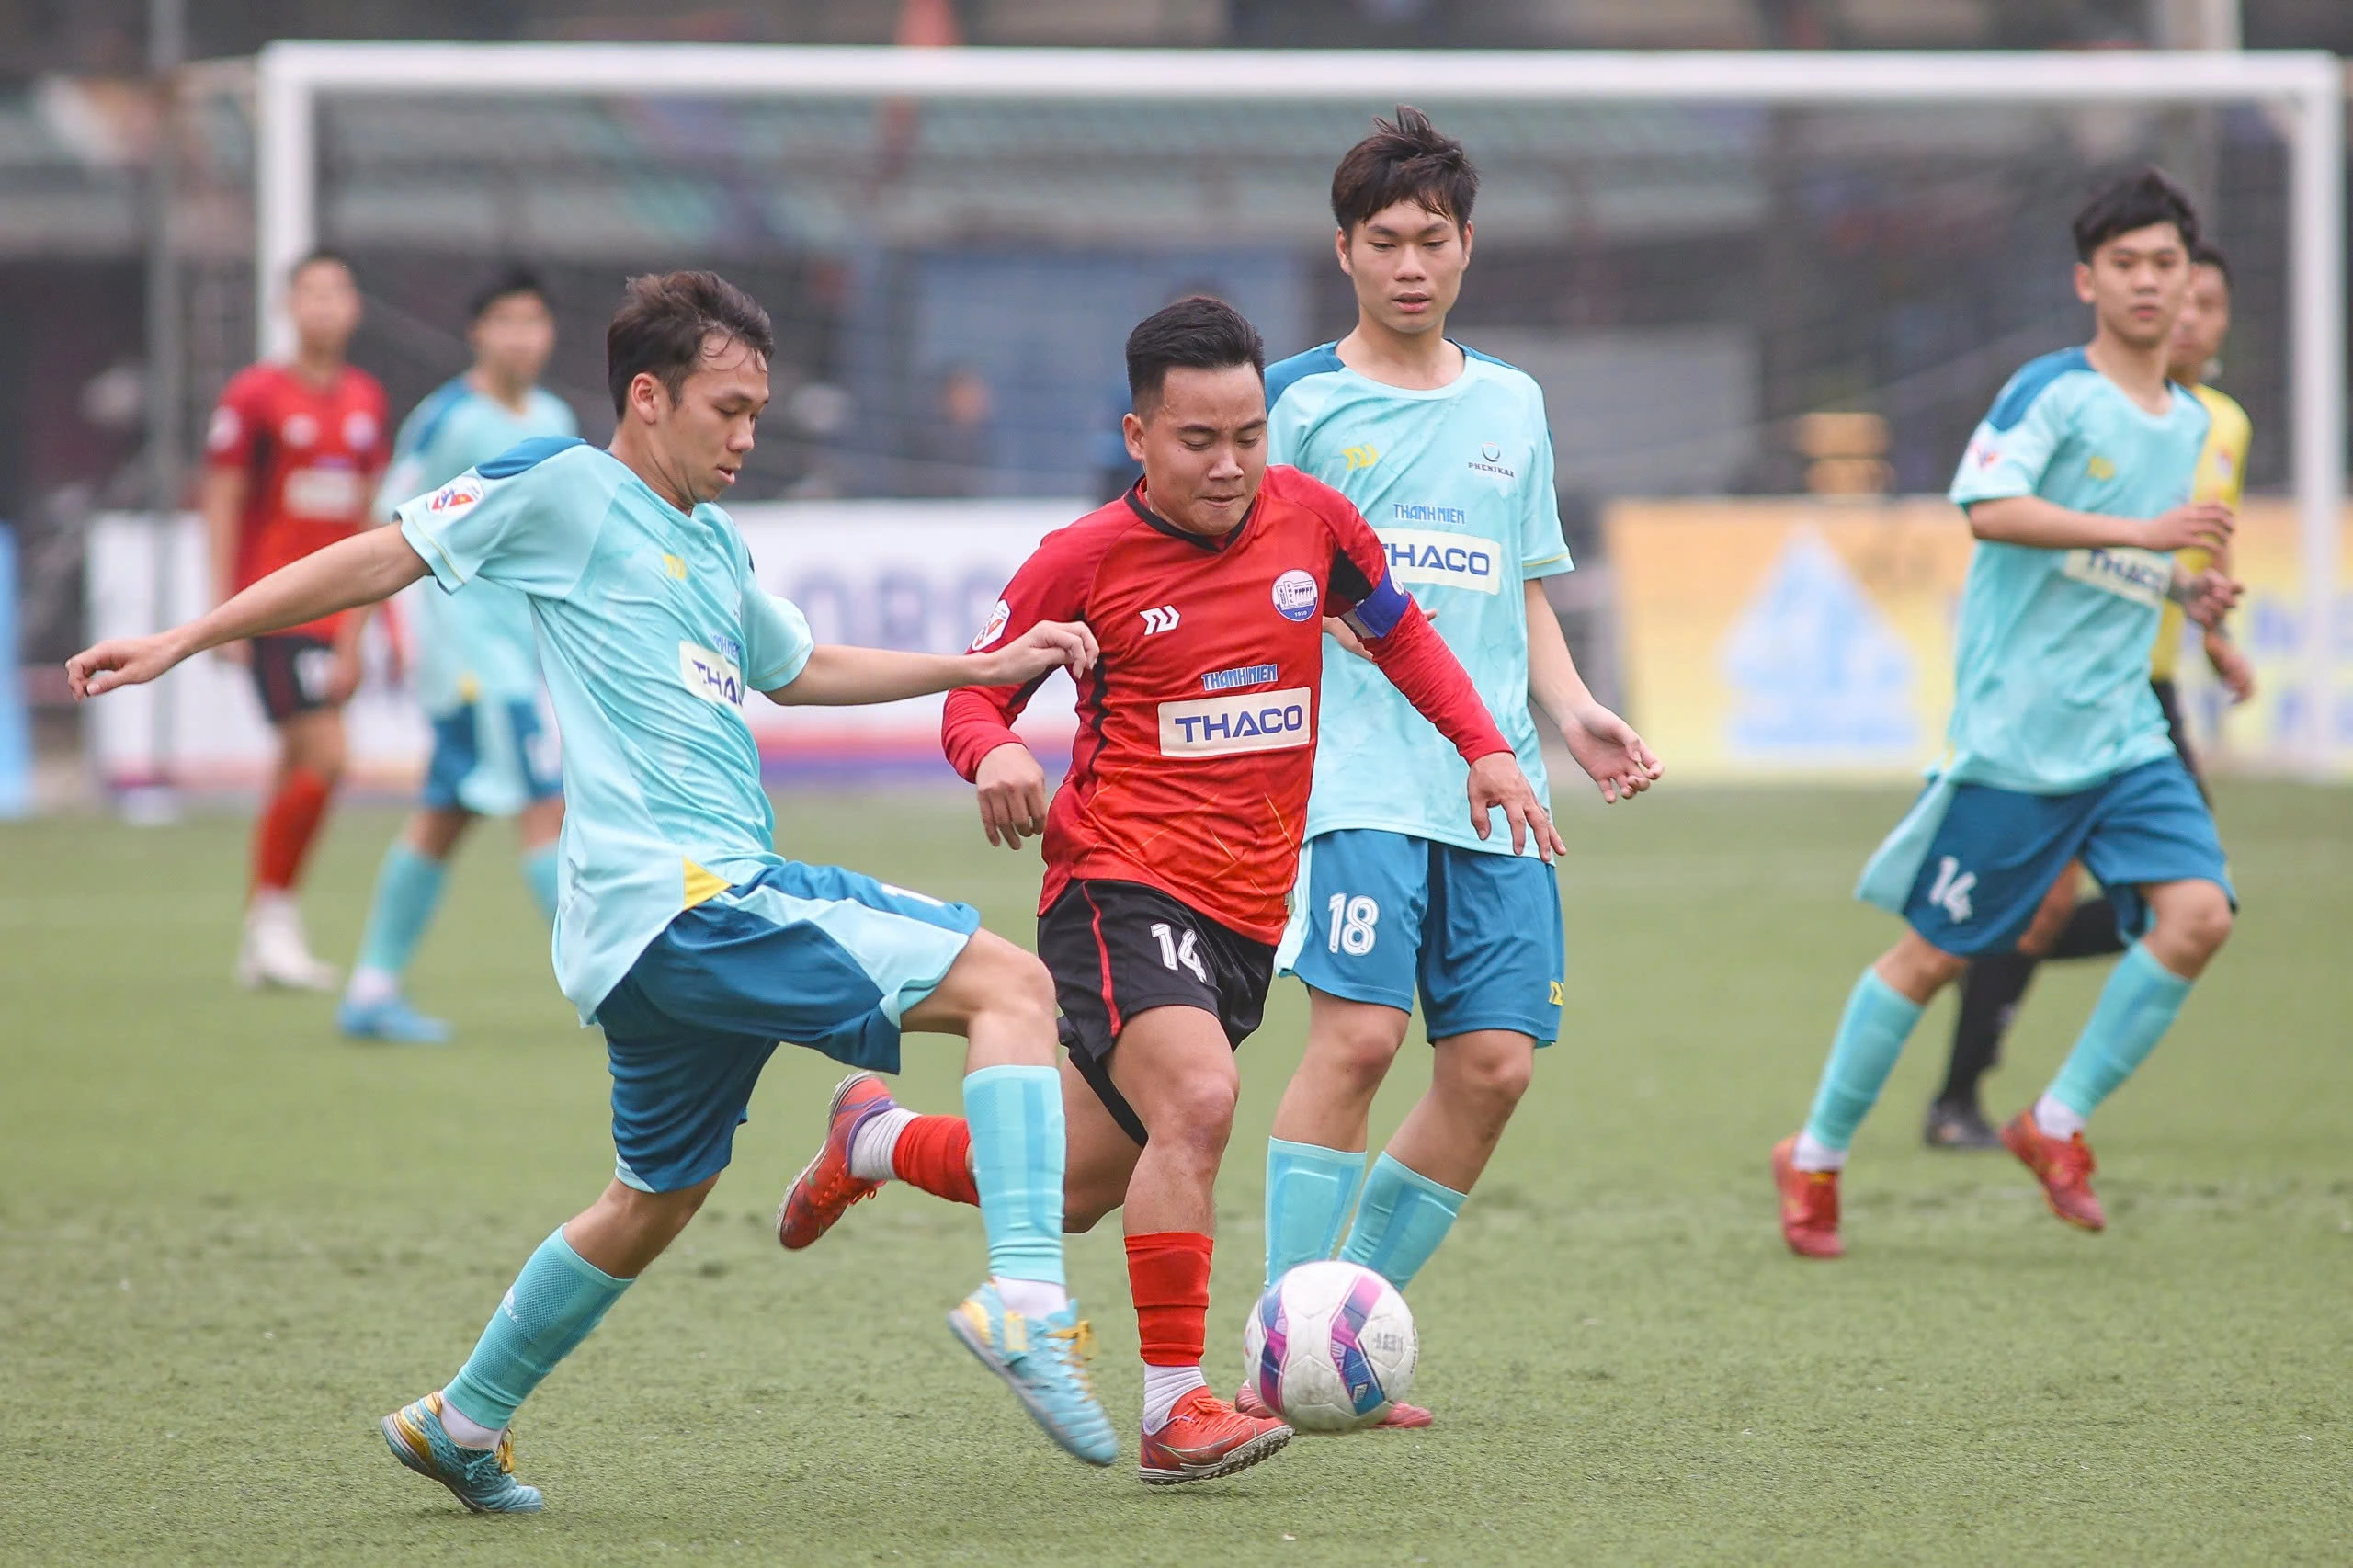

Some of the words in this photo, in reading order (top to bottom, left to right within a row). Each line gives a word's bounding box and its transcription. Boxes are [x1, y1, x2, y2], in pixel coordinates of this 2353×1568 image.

[1393, 504, 1436, 521] THANH
[1201, 671, 1248, 691] THANH
[1175, 704, 1302, 743] THACO
[1929, 855, 1977, 925] 14
[1328, 892, 1380, 956] 18
[1151, 923, 1207, 983] 14
